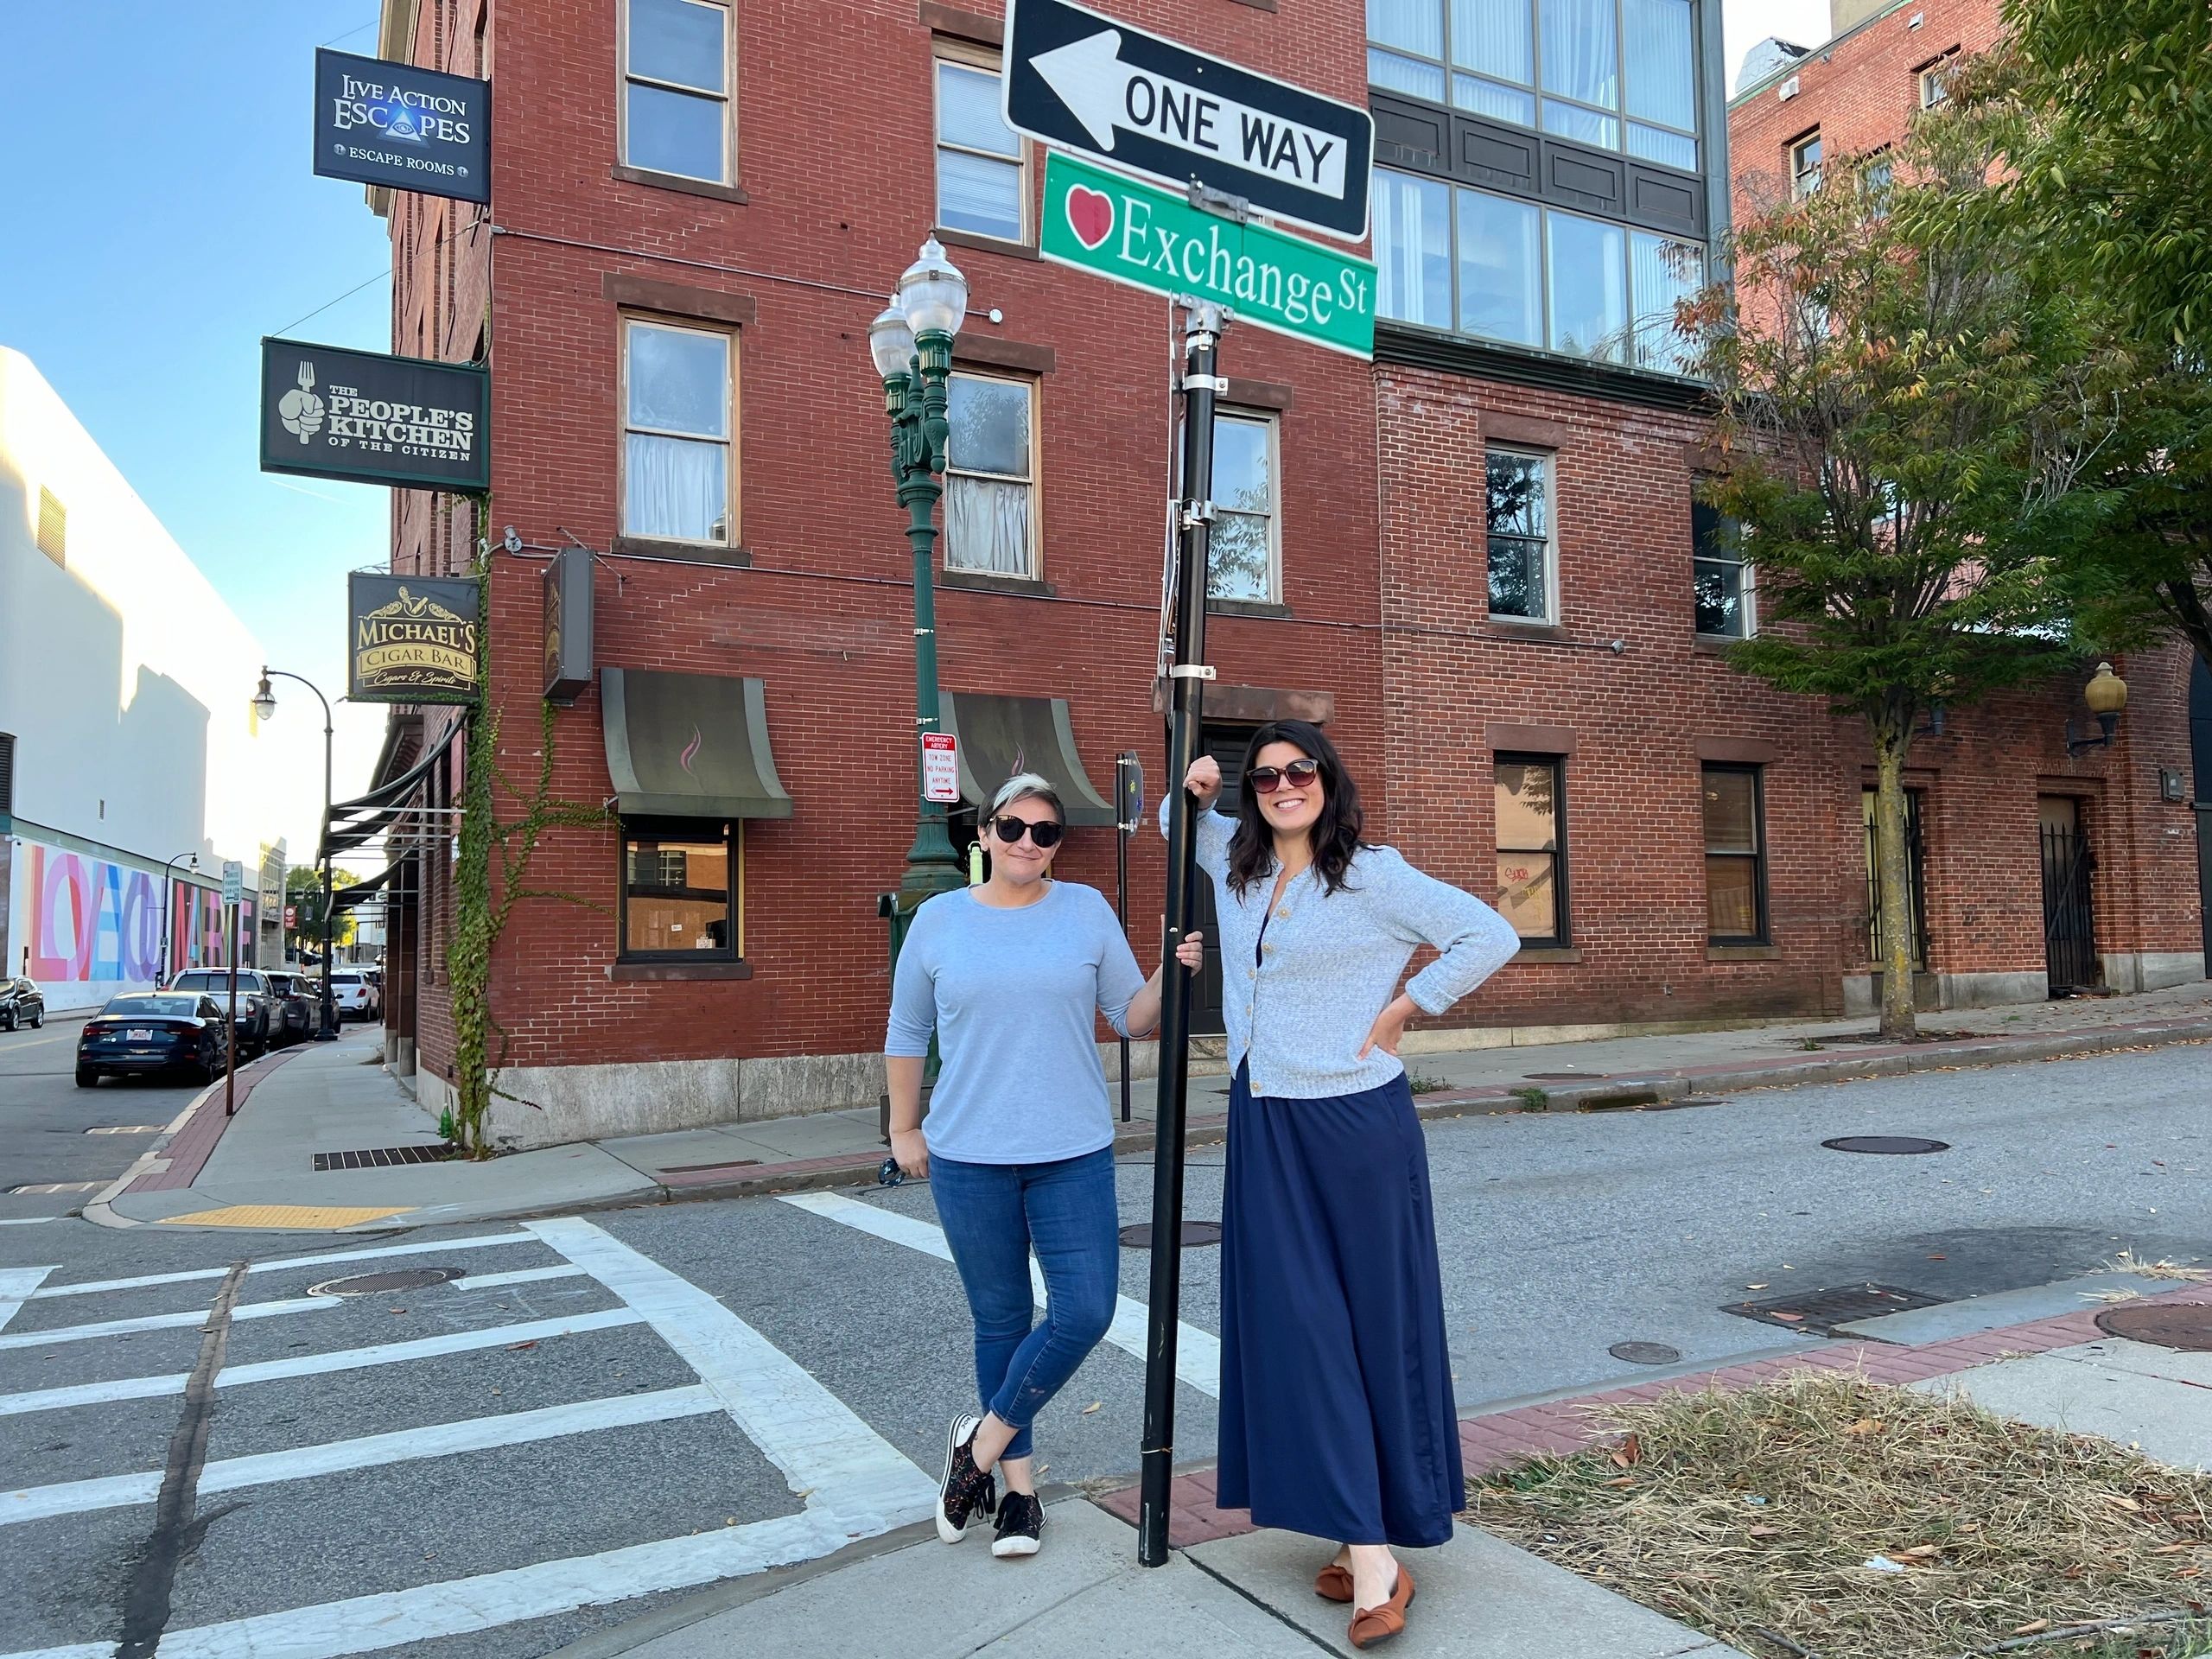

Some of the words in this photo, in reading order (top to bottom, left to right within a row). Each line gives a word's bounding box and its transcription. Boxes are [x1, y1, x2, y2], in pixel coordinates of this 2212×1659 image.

[341, 74, 384, 99] LIVE
[388, 86, 466, 117] ACTION
[1126, 75, 1220, 151] ONE
[1241, 112, 1334, 184] WAY
[349, 147, 403, 166] ESCAPE
[406, 157, 454, 176] ROOMS
[1116, 194, 1332, 325] Exchange
[1338, 268, 1367, 315] St
[329, 385, 358, 397] THE
[328, 396, 473, 430] PEOPLE'S
[328, 416, 473, 450] KITCHEN
[328, 436, 350, 447] OF
[359, 441, 392, 452] THE
[402, 446, 470, 461] CITIZEN
[357, 620, 474, 653] MICHAEL'S
[367, 650, 423, 665] CIGAR
[432, 650, 465, 671] BAR
[373, 672, 406, 686] Cigars
[422, 672, 456, 684] Spirits
